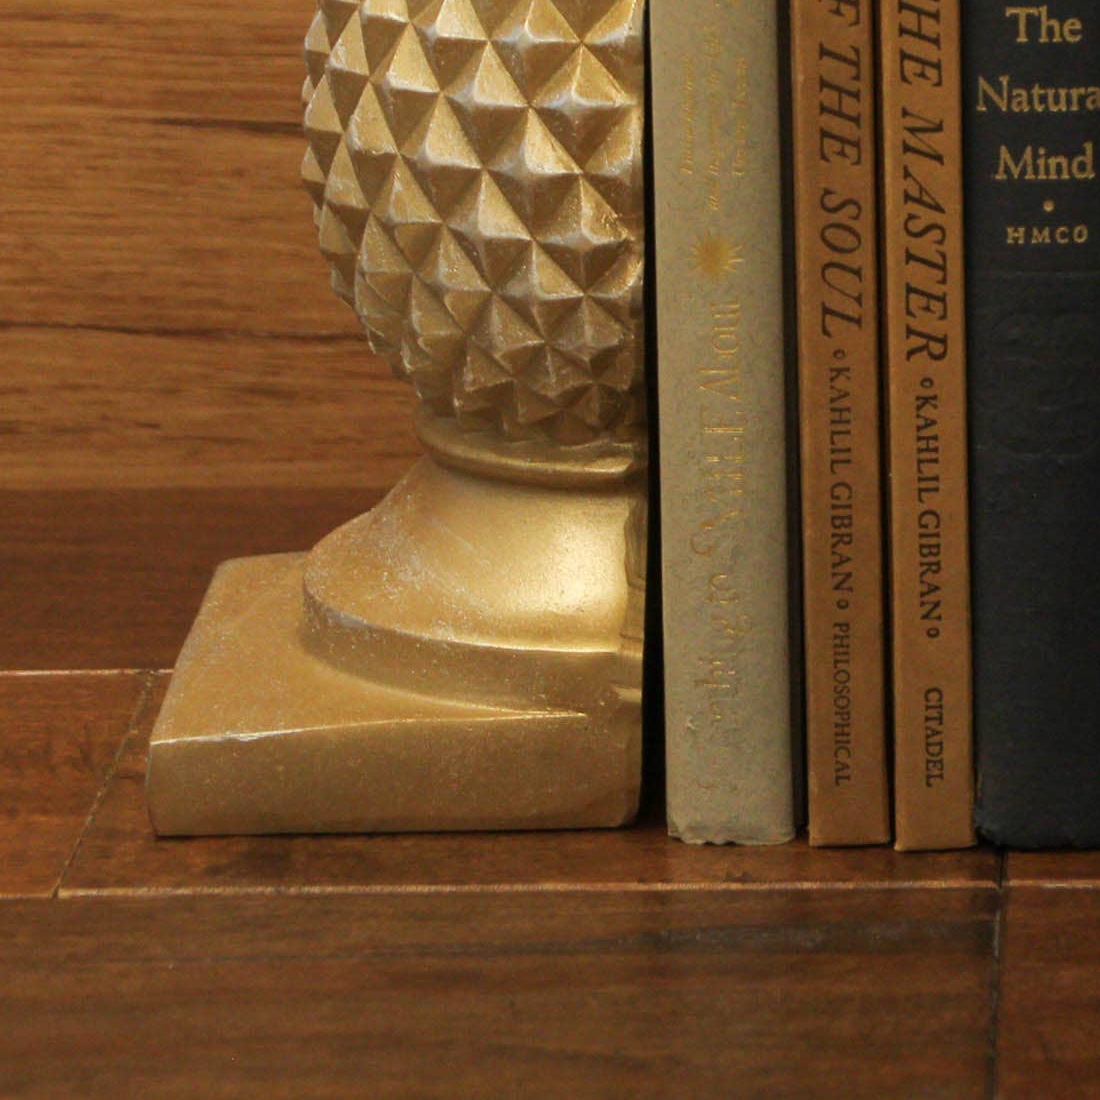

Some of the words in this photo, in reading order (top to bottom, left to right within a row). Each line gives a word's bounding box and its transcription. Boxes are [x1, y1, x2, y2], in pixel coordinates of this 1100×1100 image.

[1005, 5, 1084, 43] The
[818, 42, 863, 167] THE
[994, 142, 1097, 181] Mind
[819, 187, 864, 338] SOUL
[901, 106, 948, 363] MASTER
[1006, 224, 1090, 245] HMCO
[829, 366, 852, 475] KAHLIL
[915, 394, 940, 504] KAHLIL
[830, 481, 855, 593] GIBRAN
[917, 510, 943, 622] GIBRAN
[832, 621, 852, 788] PHILOSOPHICAL
[924, 687, 945, 789] CITADEL
